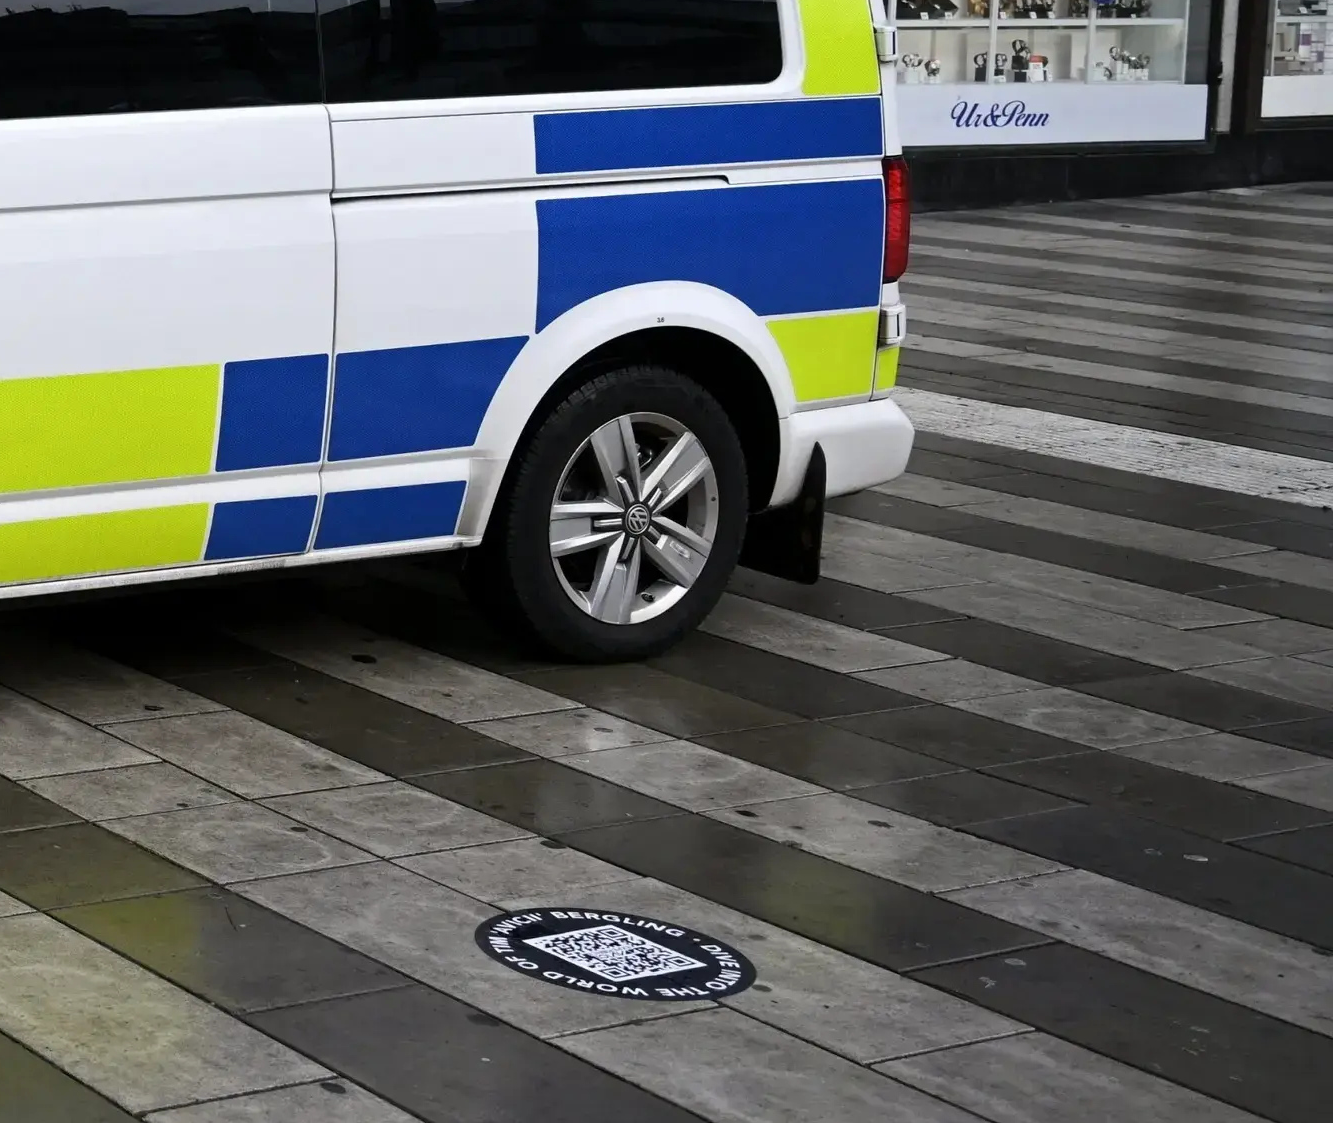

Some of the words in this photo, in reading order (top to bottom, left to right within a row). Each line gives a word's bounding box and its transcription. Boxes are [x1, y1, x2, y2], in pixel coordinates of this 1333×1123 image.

[950, 99, 1050, 127] Ur&Penn
[549, 910, 686, 937] BERGLING
[488, 936, 515, 954] TIM
[700, 944, 741, 968] DIVE
[504, 956, 539, 970] OF
[542, 971, 649, 996] WORLD
[705, 968, 742, 990] INTO
[655, 986, 710, 997] THE
